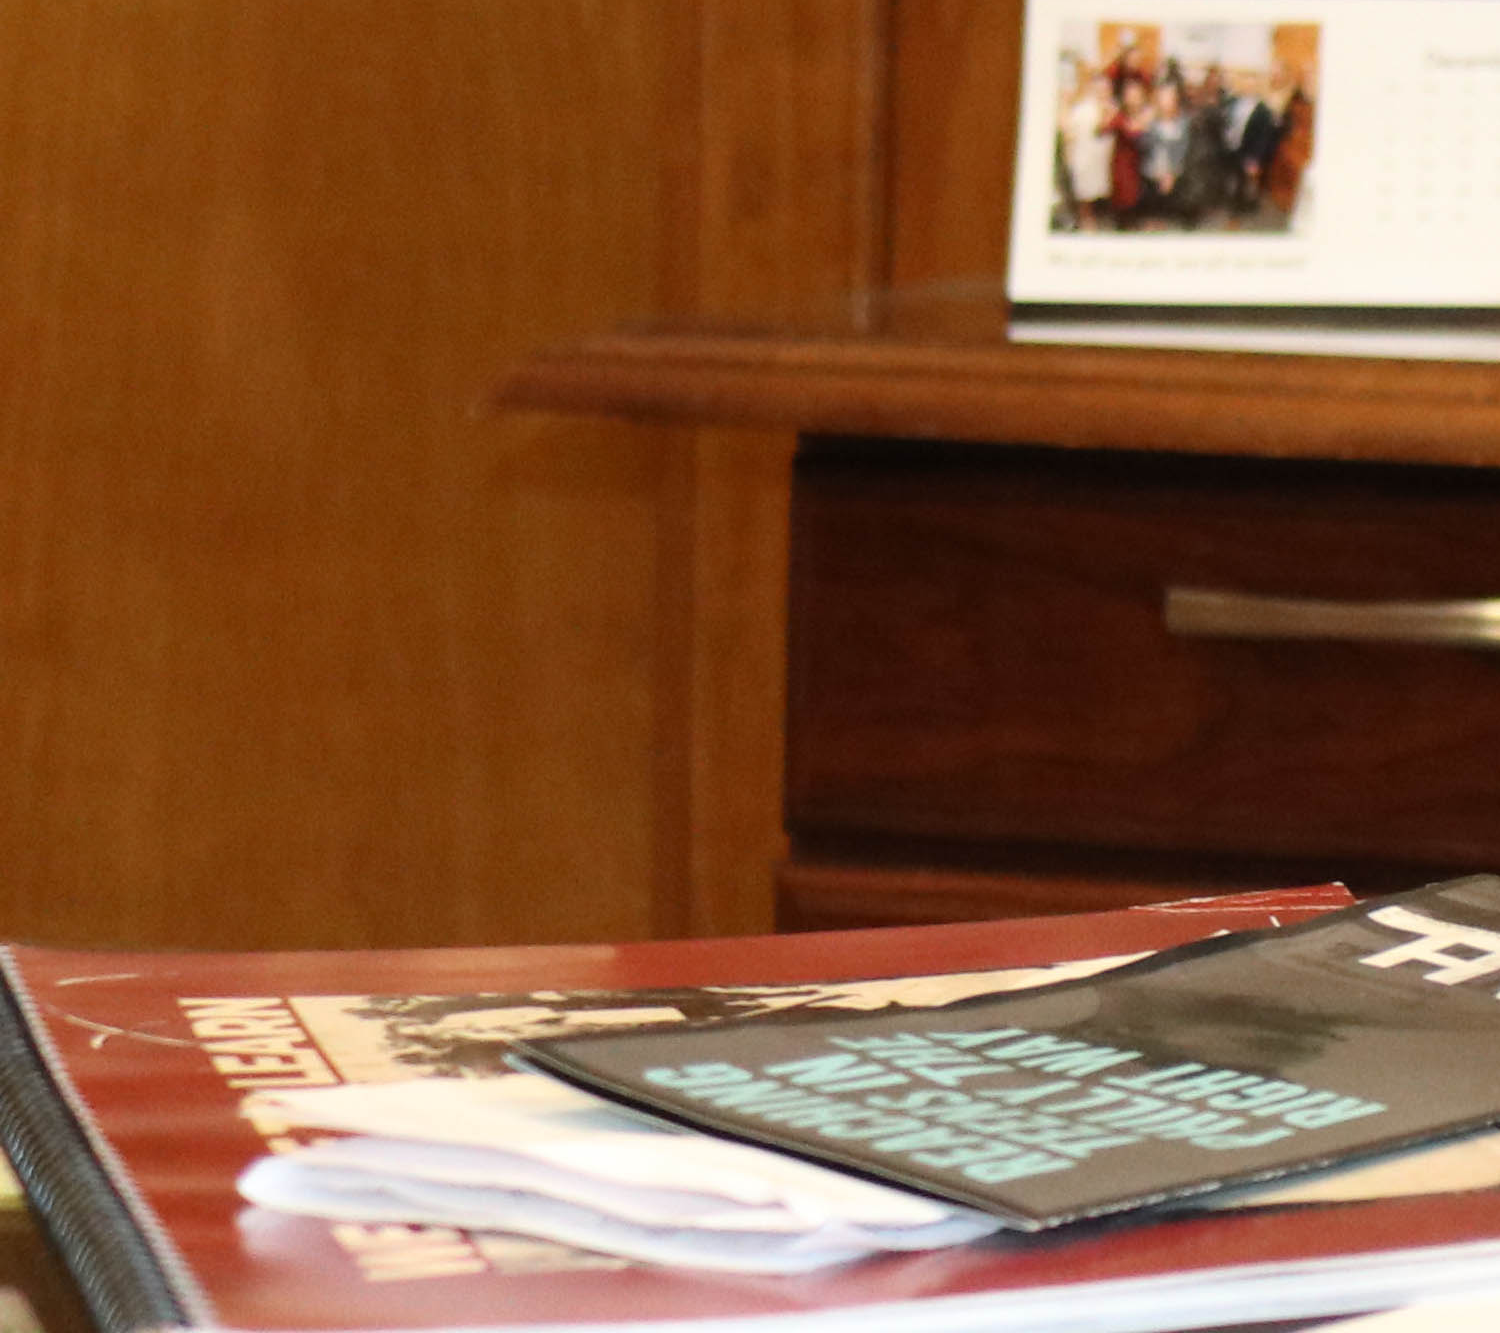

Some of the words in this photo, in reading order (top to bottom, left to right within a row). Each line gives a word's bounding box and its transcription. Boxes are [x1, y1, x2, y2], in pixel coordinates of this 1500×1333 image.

[177, 996, 343, 1089] LEARN
[761, 1053, 909, 1095] IN
[825, 1032, 1012, 1087] THE
[925, 1027, 1142, 1078] WAY
[642, 1061, 1078, 1185] REACHING
[866, 1089, 1140, 1162] TEENS
[978, 1077, 1295, 1151] PHILLY
[1103, 1063, 1388, 1130] RIGHT
